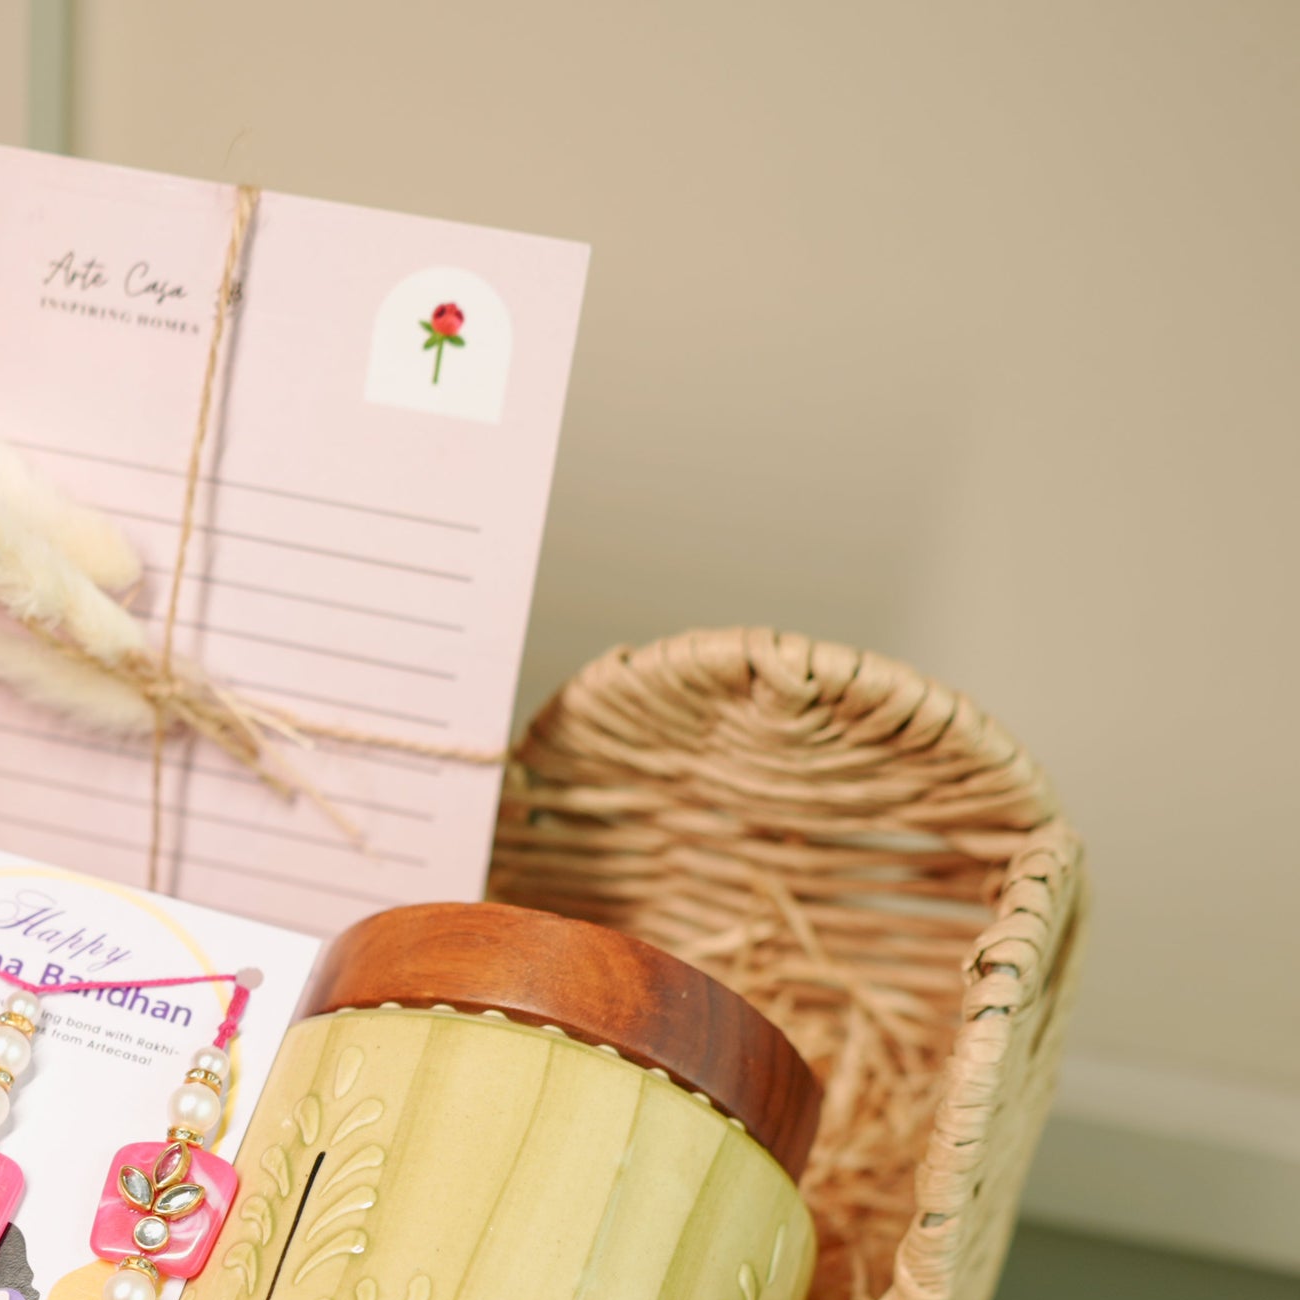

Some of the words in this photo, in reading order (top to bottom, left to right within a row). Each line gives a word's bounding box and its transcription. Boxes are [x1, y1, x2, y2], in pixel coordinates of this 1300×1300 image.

[43, 250, 108, 290] Arte
[124, 261, 188, 304] Casa
[39, 295, 132, 324] INSPIRING
[136, 314, 201, 335] HOMES
[51, 1028, 82, 1045] from
[87, 1040, 152, 1066] Artecasa!
[66, 1017, 102, 1034] bond
[105, 1029, 133, 1044] with
